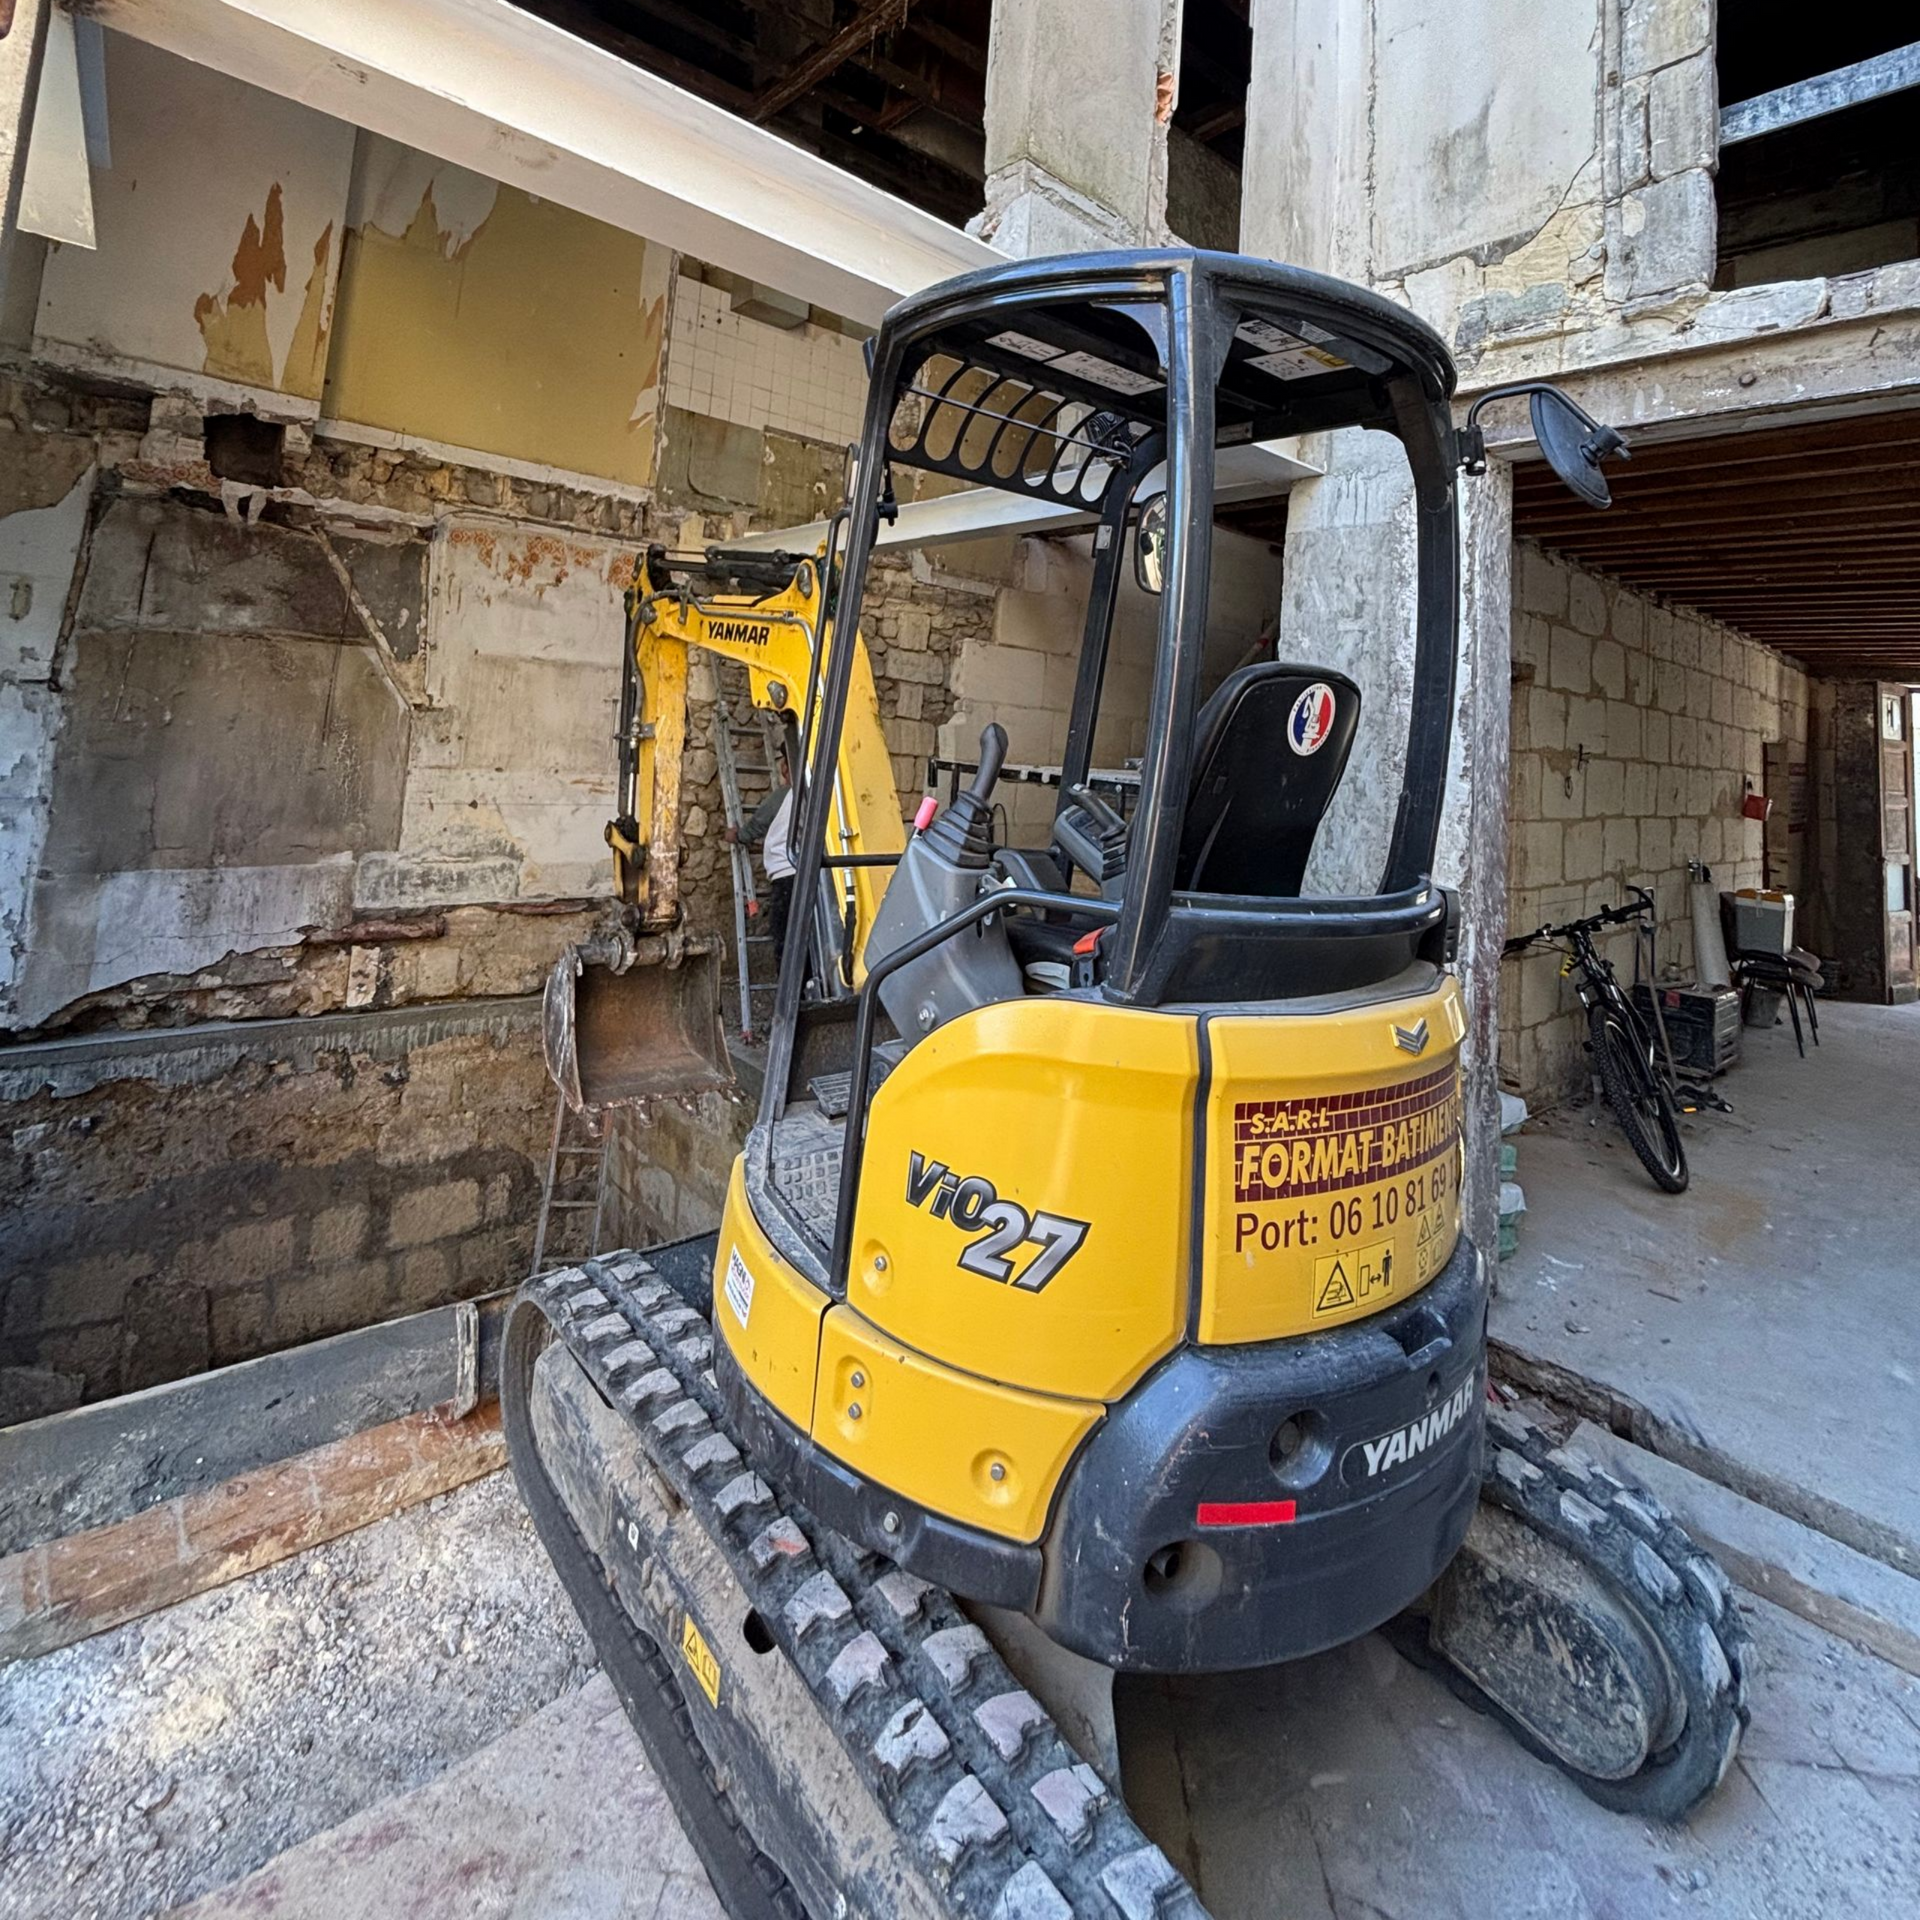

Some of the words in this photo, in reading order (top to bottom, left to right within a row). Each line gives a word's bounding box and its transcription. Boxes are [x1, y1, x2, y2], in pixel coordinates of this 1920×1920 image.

[708, 621, 770, 646] YANMAR
[1240, 1132, 1374, 1190] FORMAT
[1236, 1209, 1318, 1253] Port:
[1329, 1197, 1362, 1240] 06
[1372, 1186, 1398, 1230] 10
[1405, 1174, 1426, 1218] 81
[1431, 1163, 1446, 1203] 69
[1363, 1374, 1475, 1476] YANMAR
